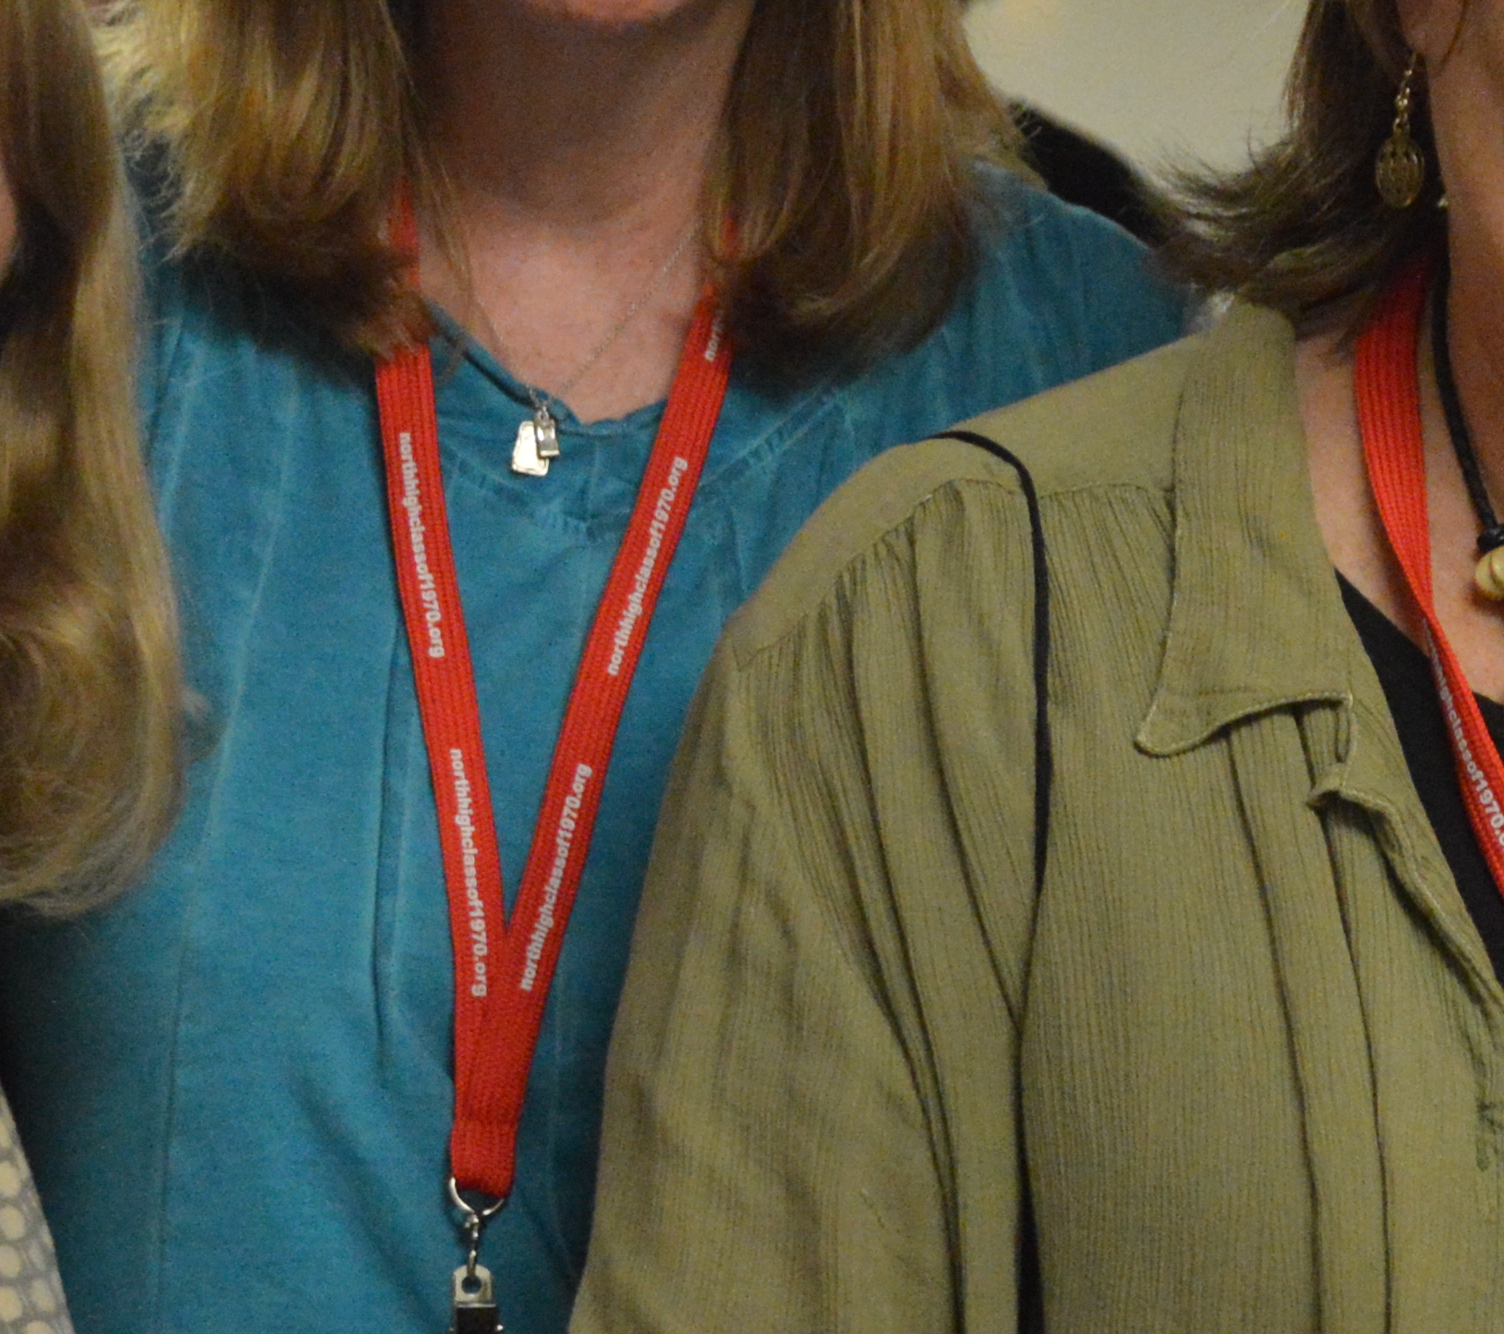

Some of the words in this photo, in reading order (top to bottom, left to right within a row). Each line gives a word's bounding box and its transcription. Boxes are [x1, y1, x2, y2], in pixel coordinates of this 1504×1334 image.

[399, 432, 444, 658] northhighclassof1970.org
[607, 456, 687, 675] northhighclassof1970.org
[450, 748, 487, 997] northhighclassof1970.org
[520, 763, 592, 991] northhighclassof1970.org
